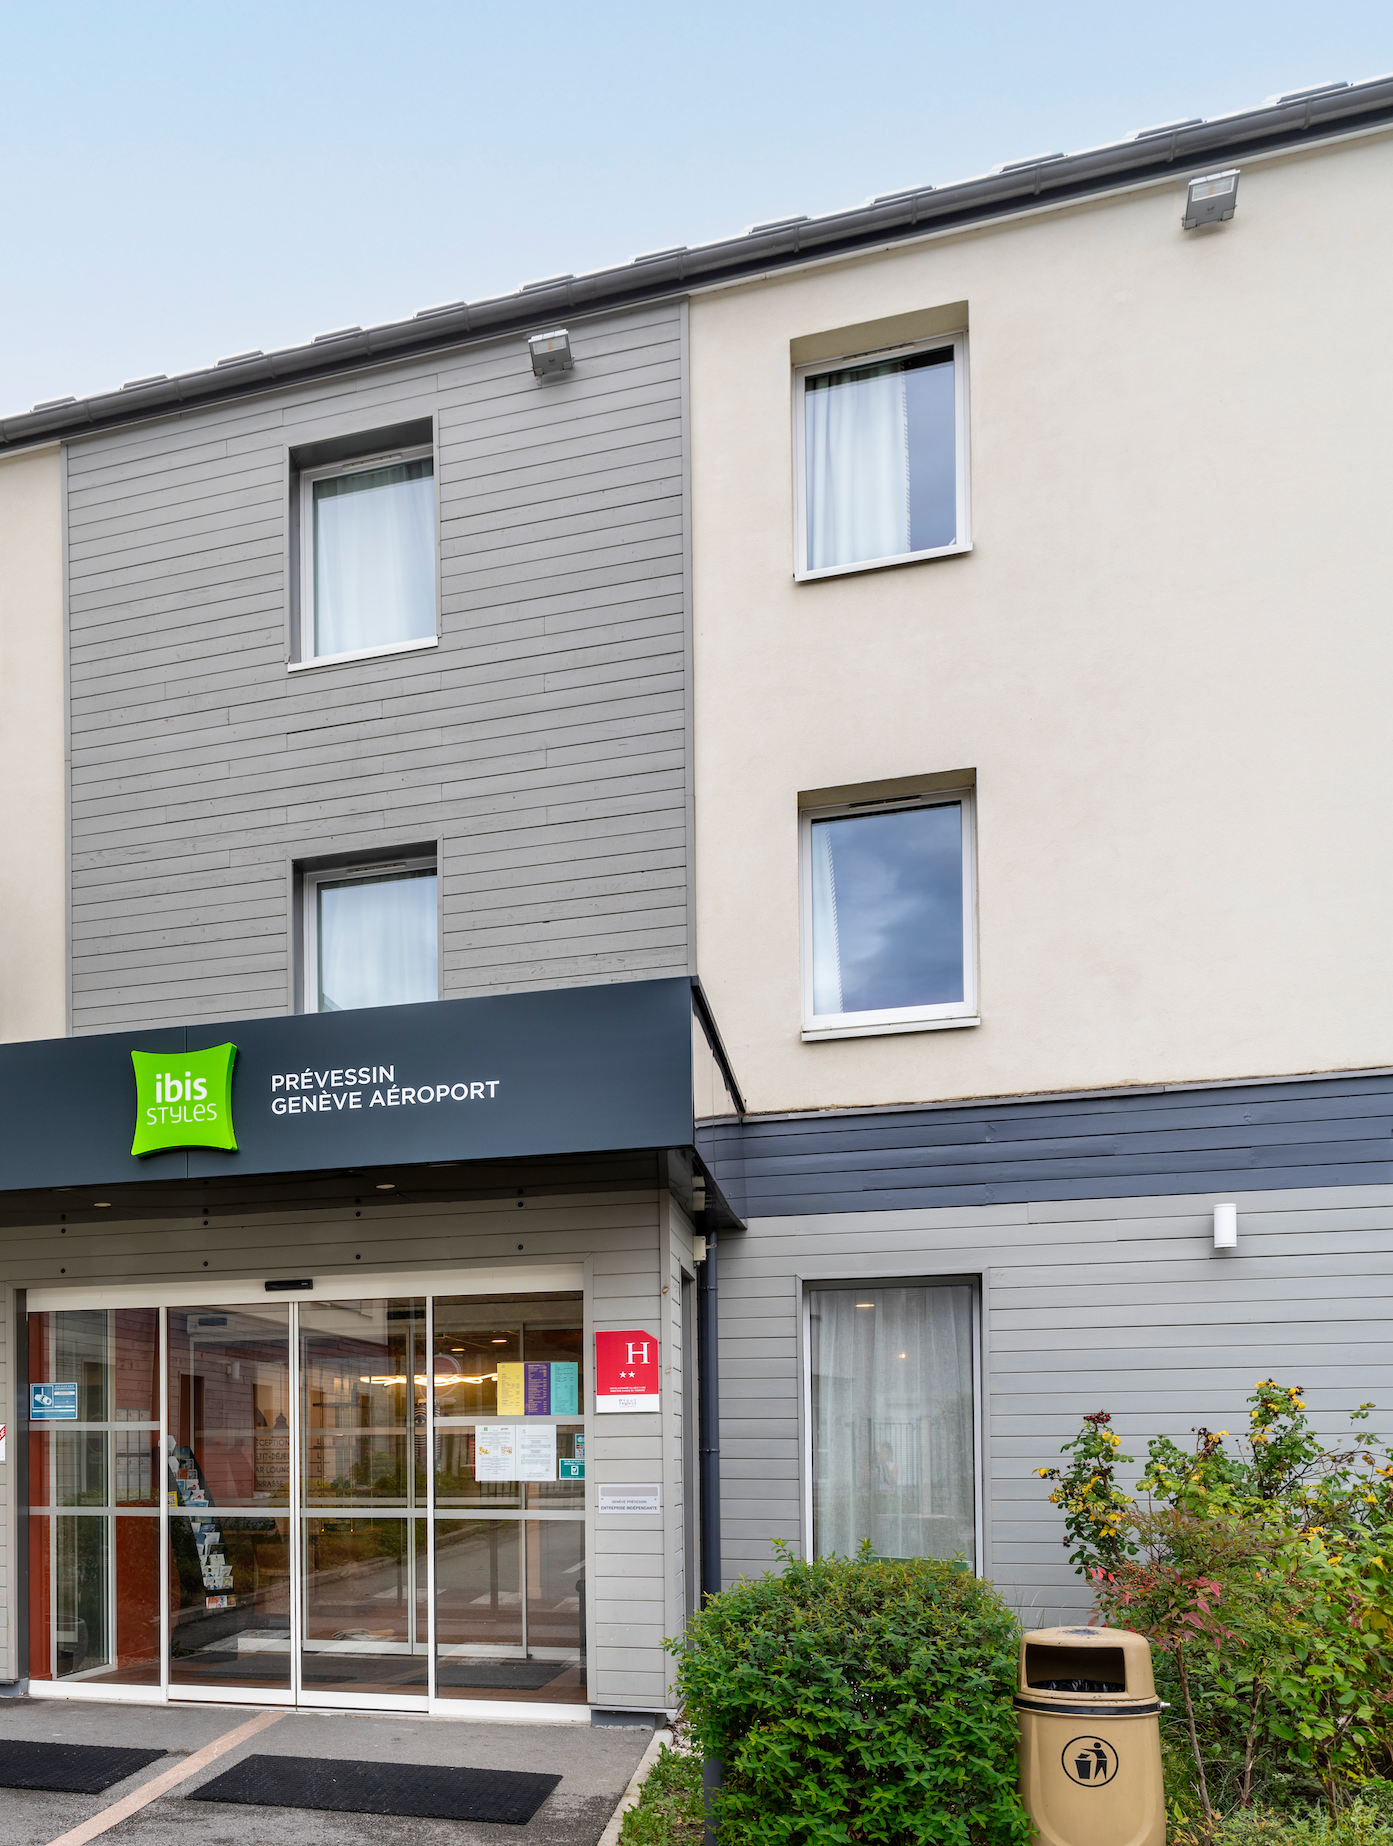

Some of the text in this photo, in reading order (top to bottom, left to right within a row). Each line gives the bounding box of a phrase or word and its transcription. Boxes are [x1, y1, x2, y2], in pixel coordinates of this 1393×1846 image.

[155, 1071, 208, 1103] ibis
[271, 1065, 396, 1092] PRÉVESSIN
[271, 1080, 500, 1116] GENÈVE AÉROPORT
[625, 1342, 650, 1364] H
